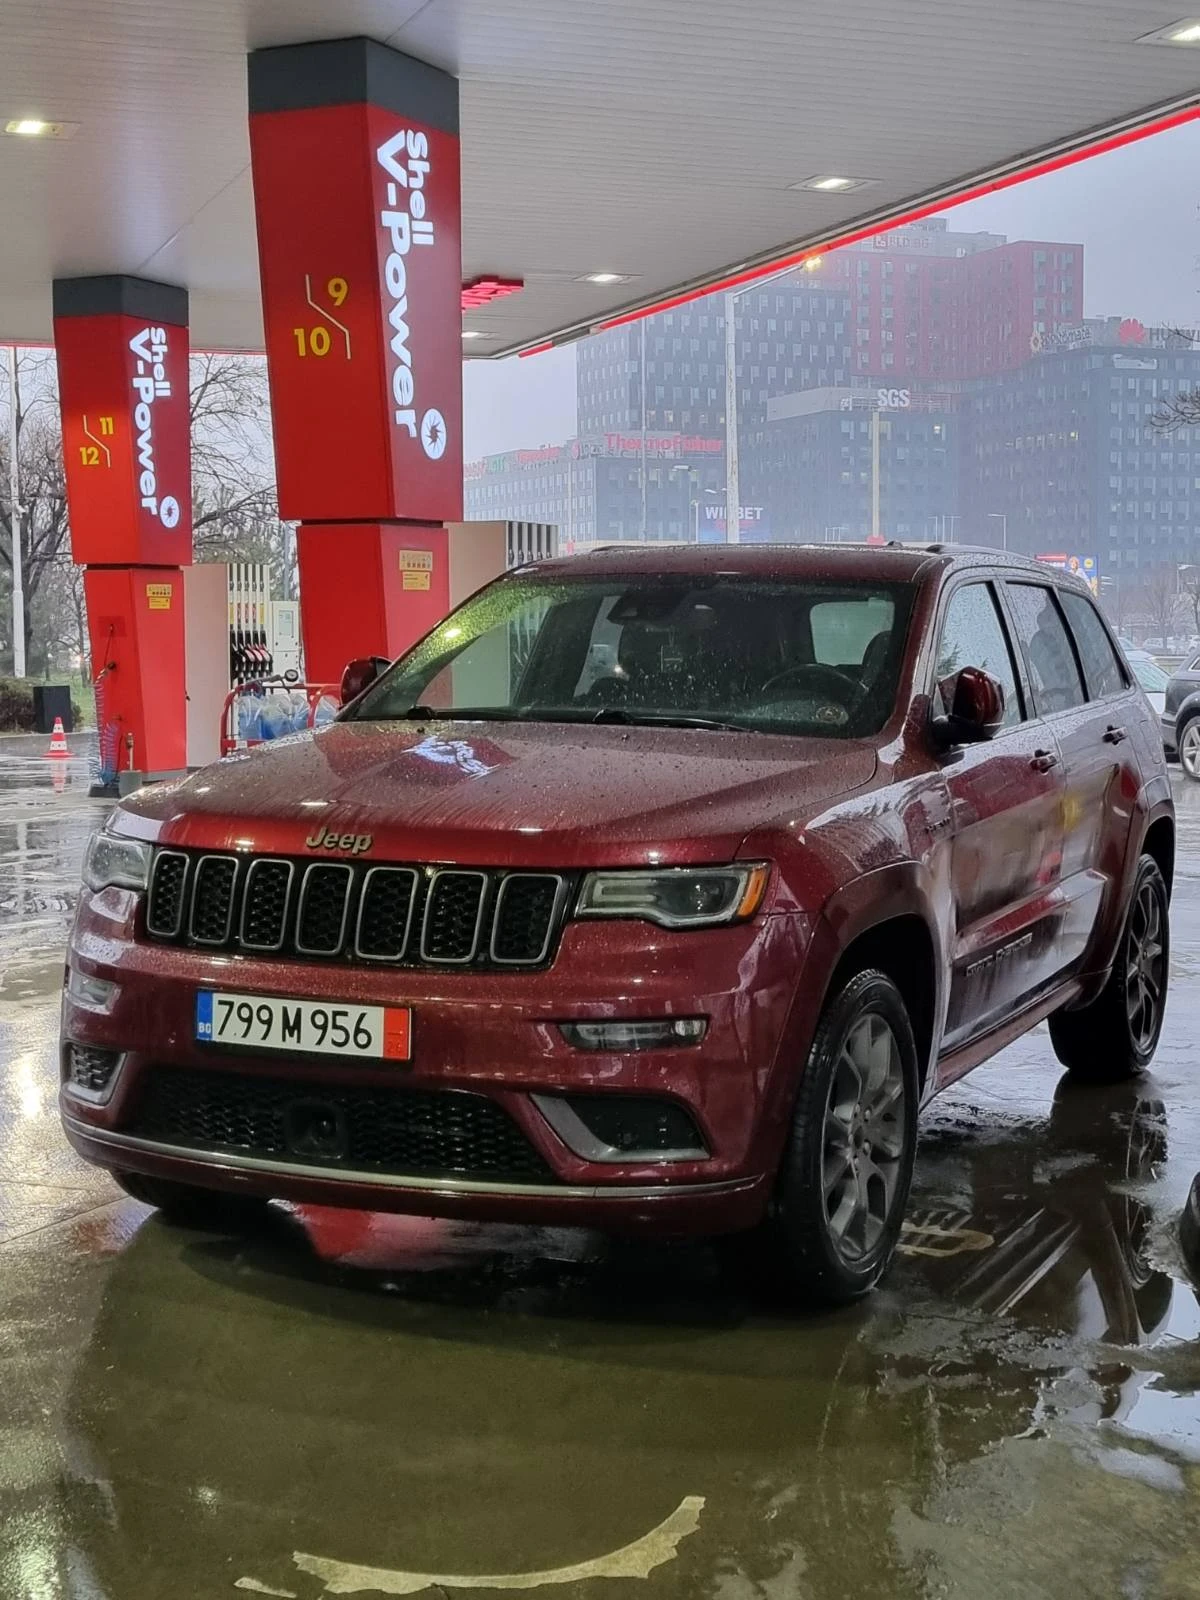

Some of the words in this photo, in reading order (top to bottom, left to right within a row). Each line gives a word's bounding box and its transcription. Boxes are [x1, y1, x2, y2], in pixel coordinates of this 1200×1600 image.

[407, 129, 434, 245] Shell
[327, 277, 349, 306] 9
[377, 129, 417, 438] V-Power
[293, 326, 331, 357] 10
[149, 326, 171, 397] Shell
[877, 388, 911, 408] SGS
[99, 416, 114, 435] 11
[129, 327, 157, 516] V-Power
[79, 446, 99, 465] 12
[704, 506, 764, 520] WIBET
[305, 826, 373, 855] Jeep
[217, 999, 274, 1041] 799
[281, 1006, 303, 1044] M
[310, 1009, 373, 1050] 956
